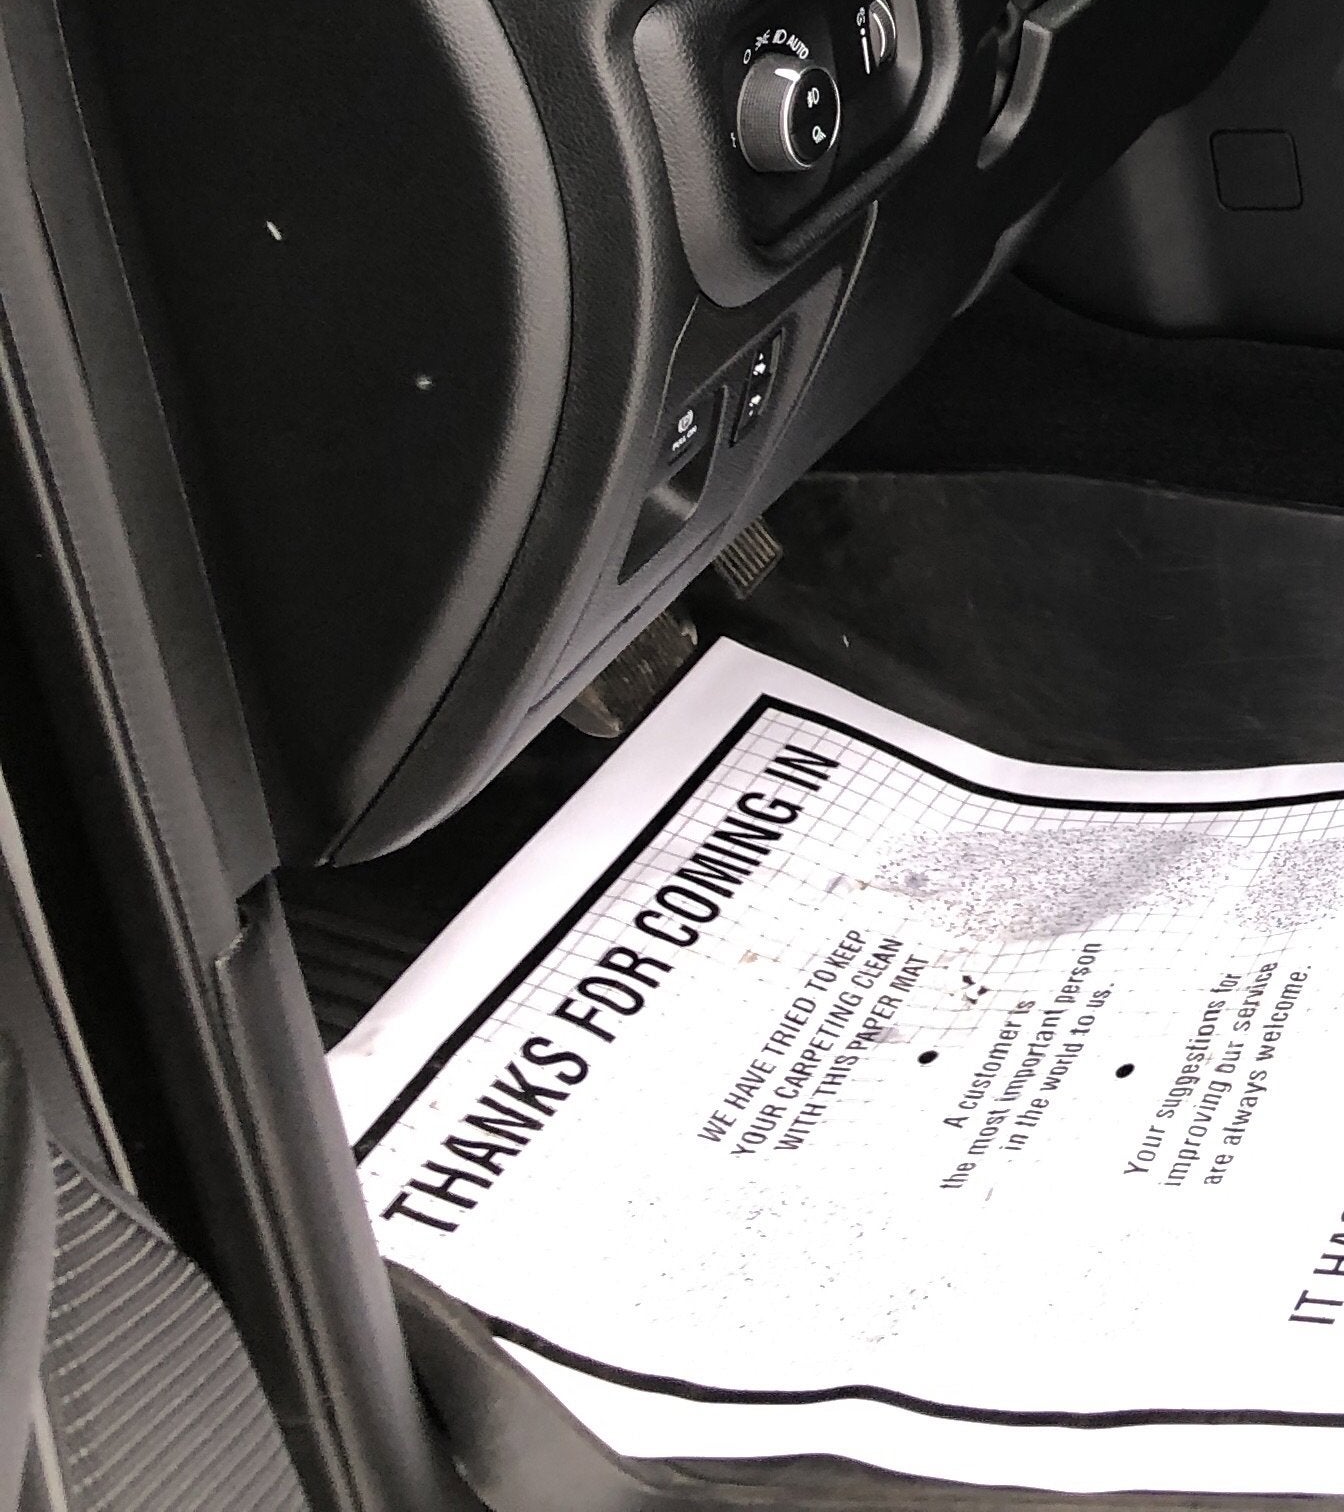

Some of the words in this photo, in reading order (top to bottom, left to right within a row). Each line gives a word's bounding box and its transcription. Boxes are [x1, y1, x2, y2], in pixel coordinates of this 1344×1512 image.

[786, 34, 810, 60] AUTO
[380, 1037, 589, 1232] THANKS
[554, 946, 675, 1043] FOR
[634, 792, 805, 947] COMING
[764, 744, 841, 791] IN
[697, 1110, 736, 1142] WE
[724, 1059, 776, 1110] HAVE
[761, 996, 817, 1055] TRIED
[804, 969, 837, 992] TO
[823, 930, 866, 969] KEEP
[730, 1104, 787, 1155] YOUR
[773, 991, 864, 1099] CARPETING
[851, 938, 904, 989] CLEAN
[773, 1102, 827, 1151] WITH
[812, 1055, 860, 1096] THIS
[845, 994, 903, 1050] PAPER
[889, 954, 929, 992] MAT
[939, 1162, 976, 1189] the
[967, 1109, 1011, 1155] most
[994, 1009, 1069, 1102] important
[1054, 943, 1103, 1004] person
[942, 1116, 970, 1128] A
[958, 1021, 1022, 1110] customer
[1008, 1000, 1036, 1015] is
[999, 1133, 1029, 1150] in
[1014, 1098, 1049, 1127] the
[1039, 1044, 1084, 1092] world
[1070, 1015, 1095, 1036] to
[1086, 983, 1115, 1008] us.
[1123, 1125, 1166, 1174] Your
[1156, 1000, 1226, 1119] suggestions
[1210, 973, 1242, 994] for
[1157, 1080, 1232, 1186] improving
[1214, 1040, 1245, 1074] our
[1233, 961, 1279, 1032] service
[1204, 1153, 1234, 1185] are
[1222, 1070, 1267, 1145] always
[1255, 965, 1312, 1062] welcome.
[1288, 1290, 1344, 1325] IT
